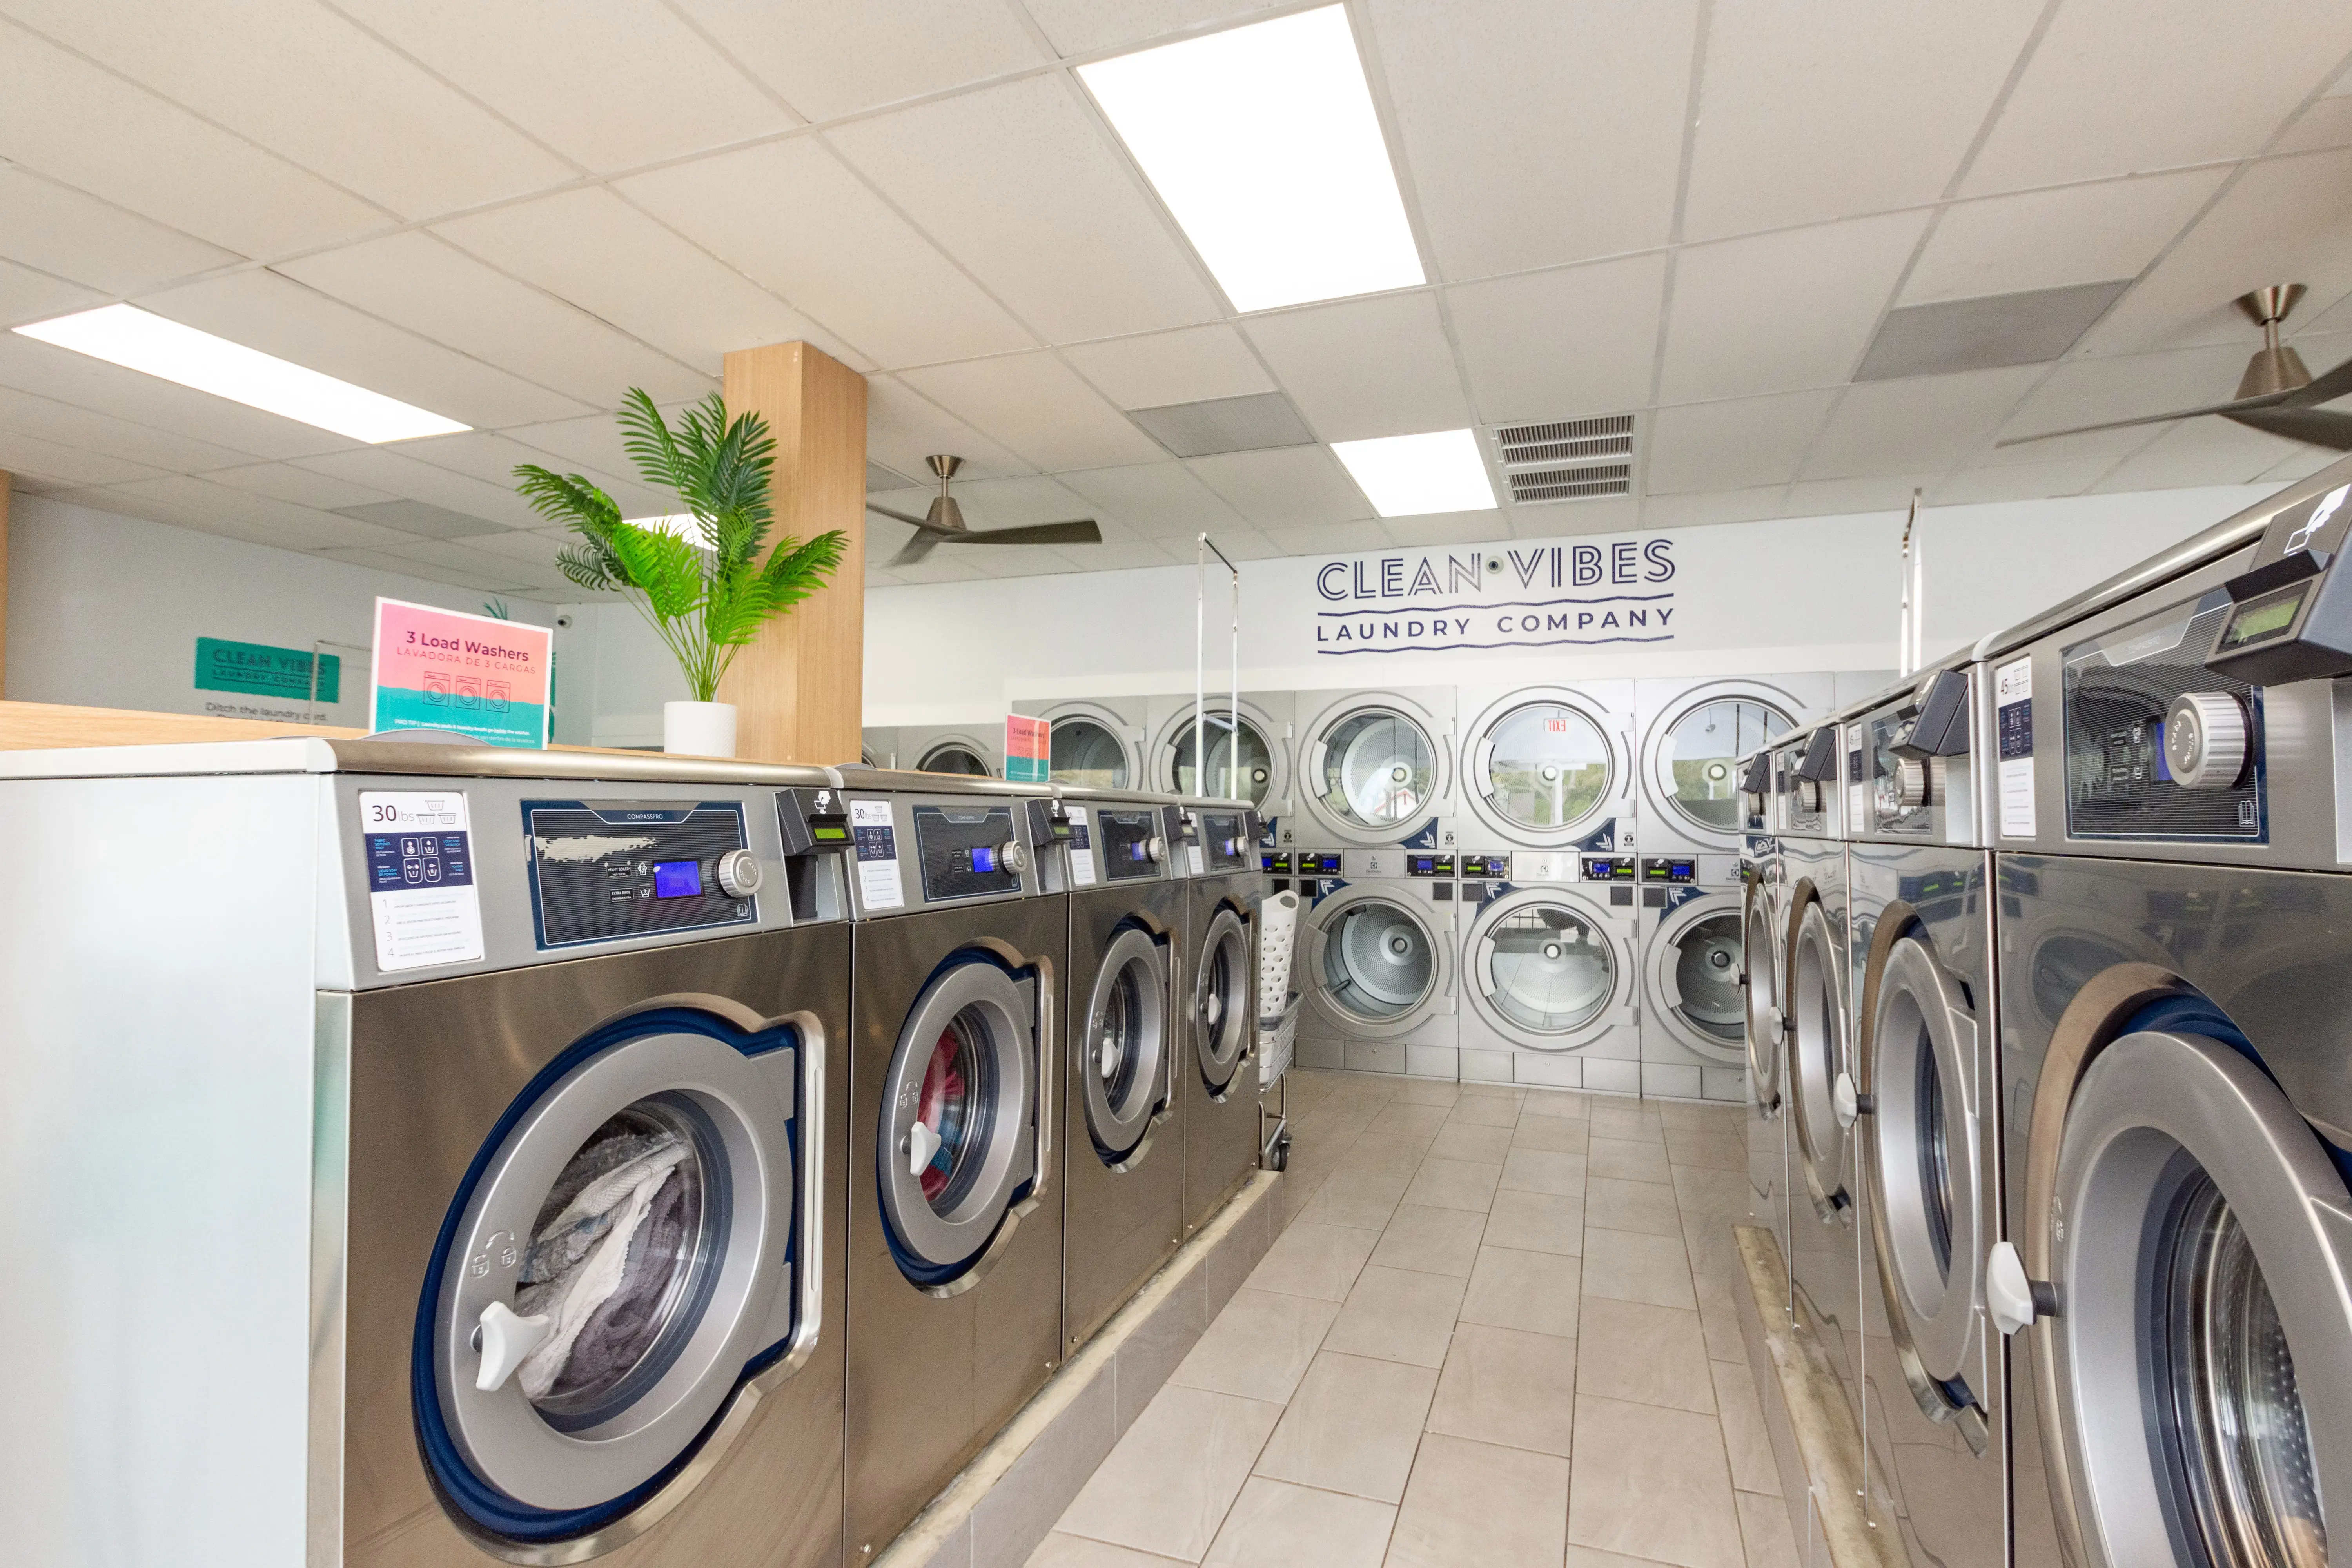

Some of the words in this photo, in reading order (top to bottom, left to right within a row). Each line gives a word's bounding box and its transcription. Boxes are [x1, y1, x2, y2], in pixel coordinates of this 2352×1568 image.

[1317, 553, 1481, 601] CLEAN
[1507, 539, 1676, 590] VIBES
[1317, 619, 1470, 642] LAUNDRY
[1497, 608, 1675, 633] COMPANY
[406, 631, 415, 644] 3
[421, 633, 459, 651] Load
[465, 640, 529, 661] Washers
[213, 649, 271, 667] CLEAN
[397, 647, 461, 664] LAVADORA
[466, 657, 480, 666] DE
[485, 659, 490, 668] 3
[495, 661, 536, 675] CARGAS
[205, 702, 237, 713] Ditch
[239, 706, 259, 715] the
[260, 707, 301, 720] laundry
[382, 899, 387, 908] 1
[384, 915, 391, 925] 2
[386, 931, 392, 941] 3
[388, 948, 395, 957] 4
